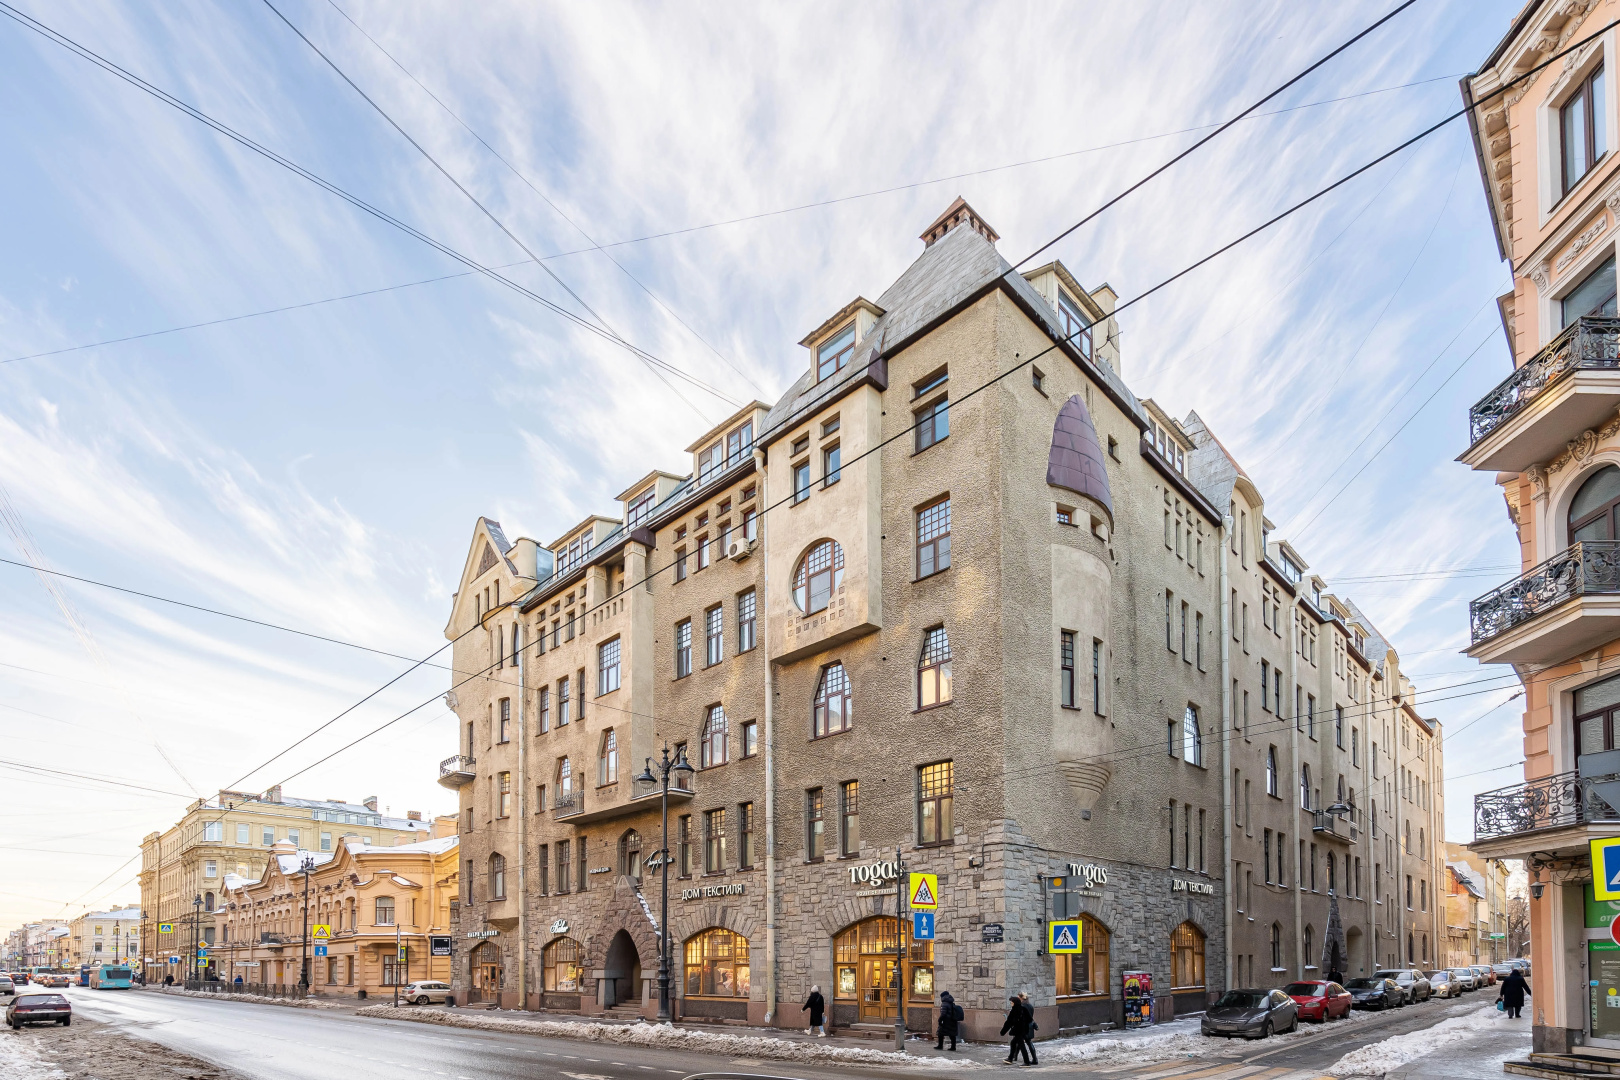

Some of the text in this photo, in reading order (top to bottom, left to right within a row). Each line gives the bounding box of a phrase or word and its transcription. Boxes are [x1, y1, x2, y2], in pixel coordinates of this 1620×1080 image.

[681, 883, 743, 901] ДОМ ТЕКСТИЛЯ
[1172, 879, 1214, 895] ДОМ ТЕКСТИЛЯ
